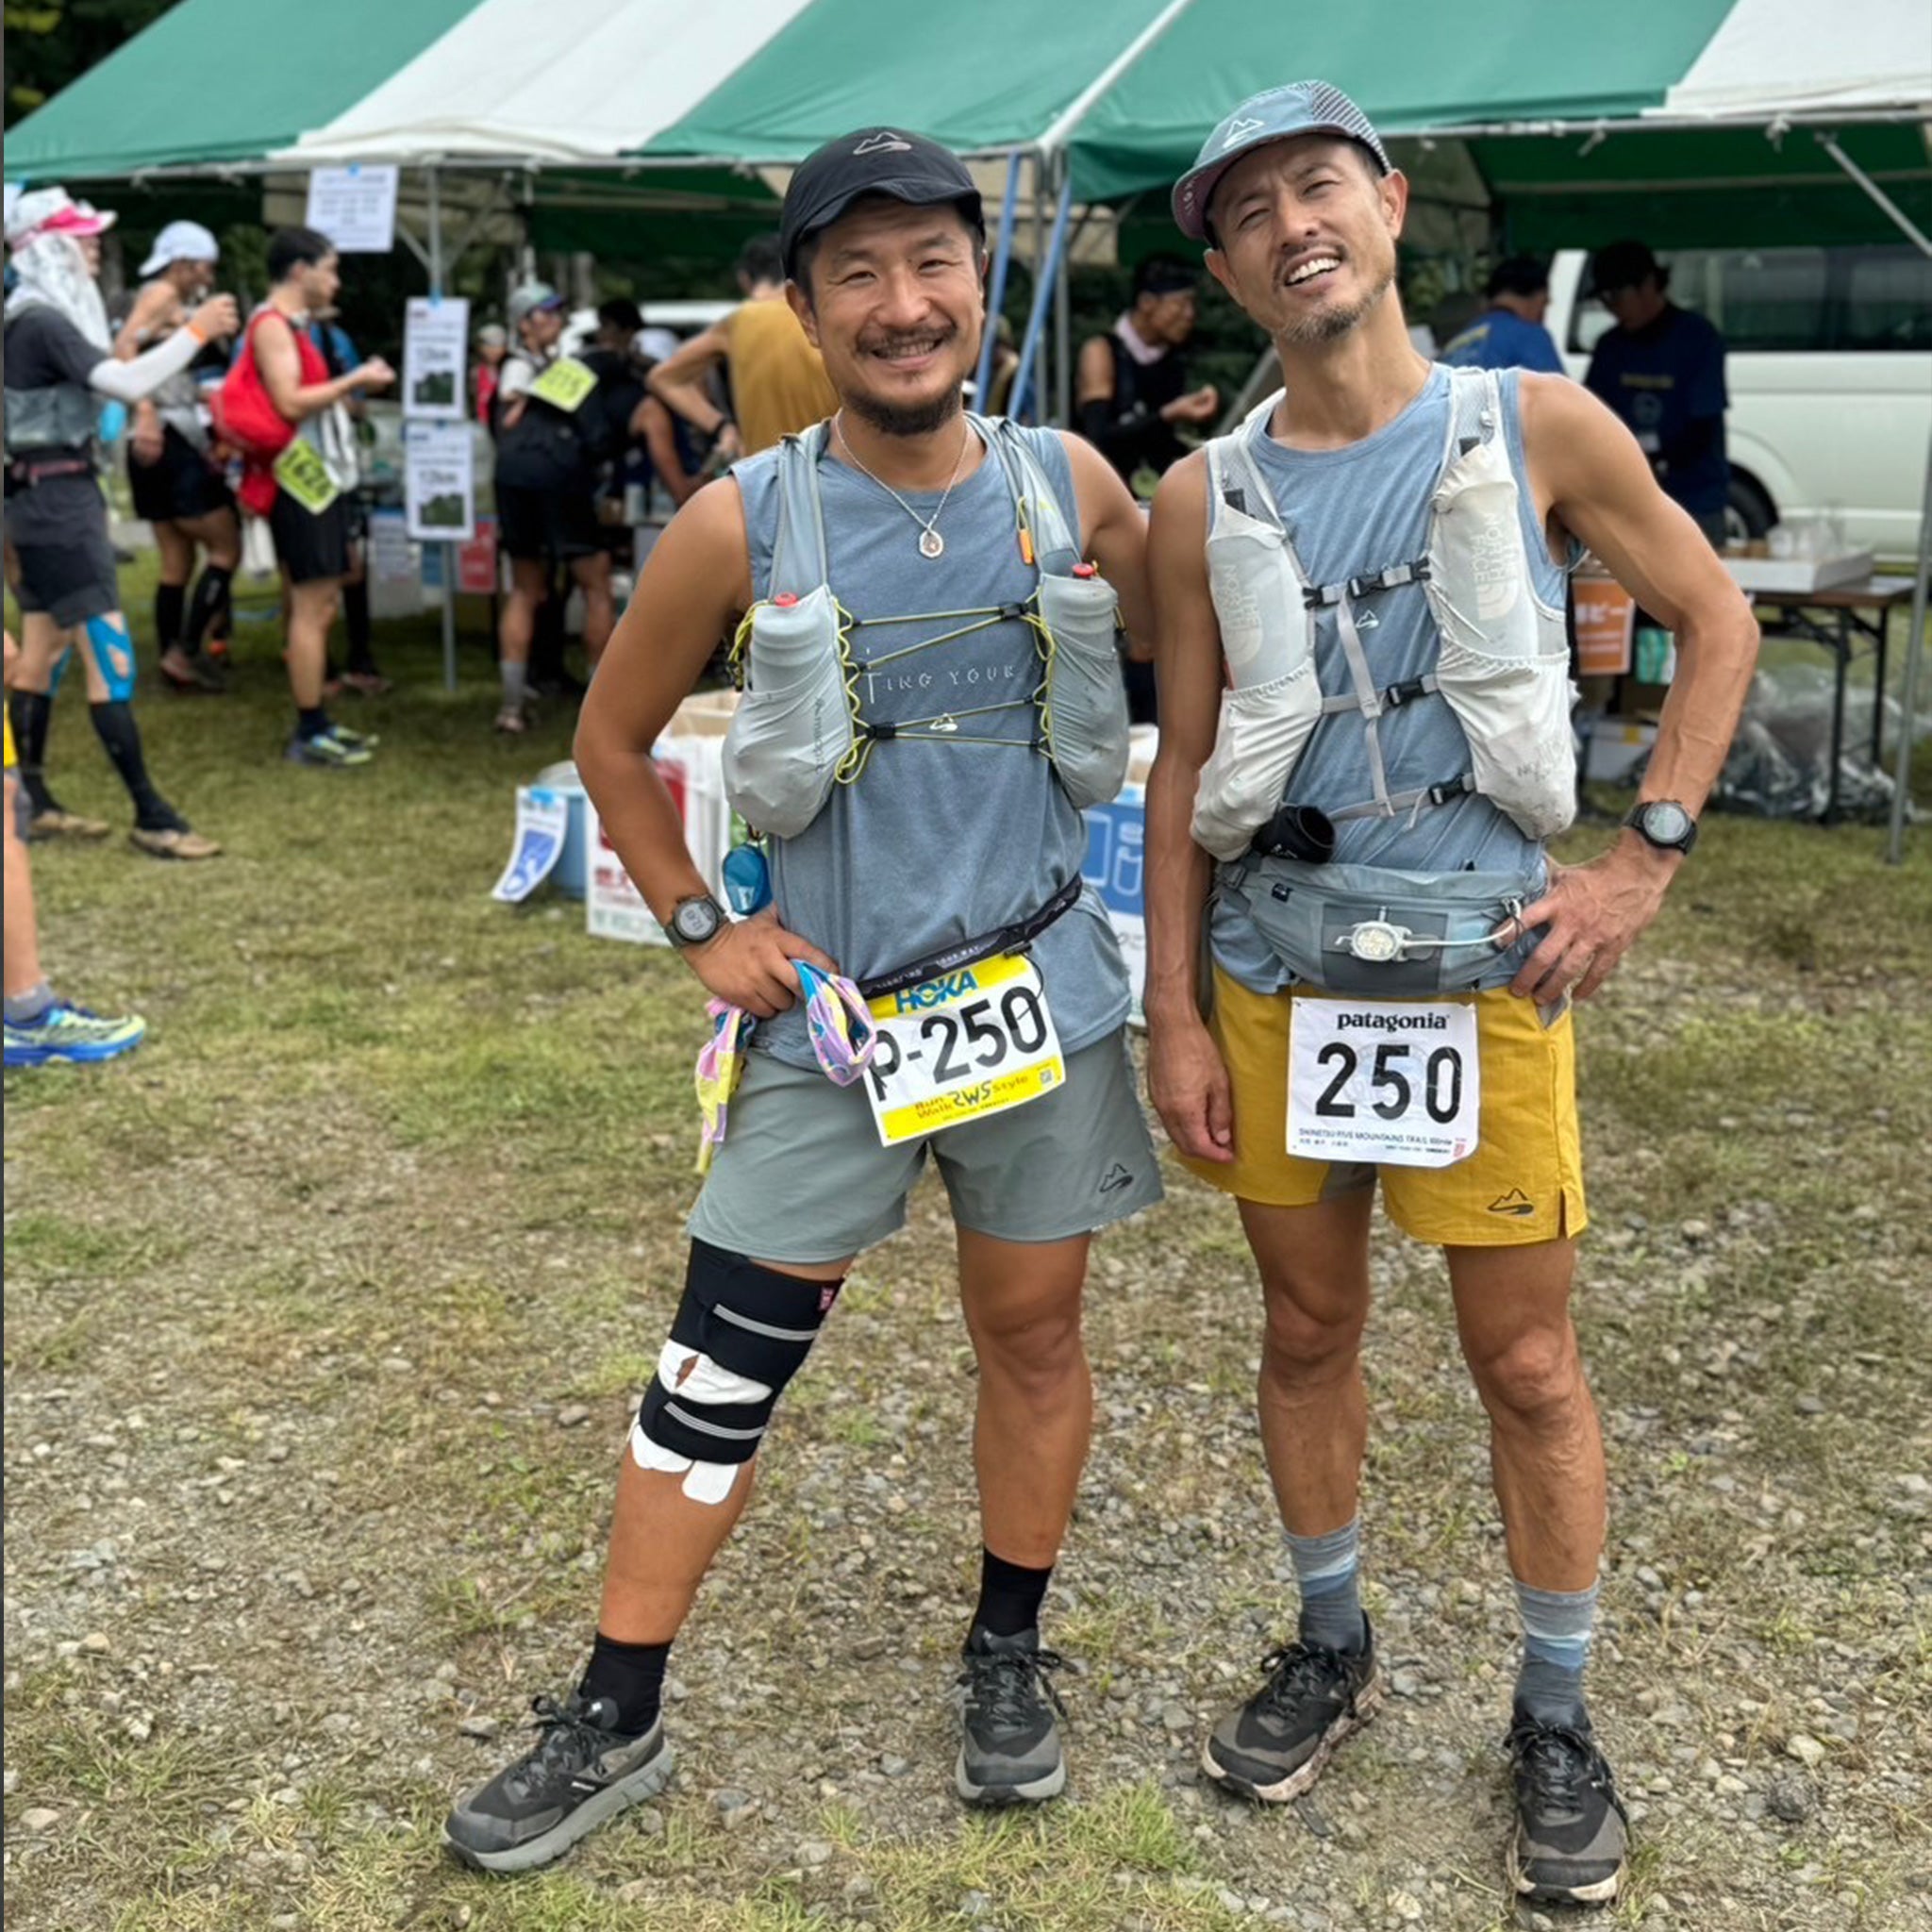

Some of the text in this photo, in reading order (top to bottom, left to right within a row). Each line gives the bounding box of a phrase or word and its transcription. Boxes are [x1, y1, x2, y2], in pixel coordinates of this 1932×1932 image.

[1470, 534, 1489, 583] FACE
[1484, 512, 1506, 581] NORTH
[895, 970, 978, 1013] HOKA
[871, 986, 1047, 1102] P-250
[1337, 1013, 1447, 1032] patagonia
[1315, 1041, 1461, 1124] 250
